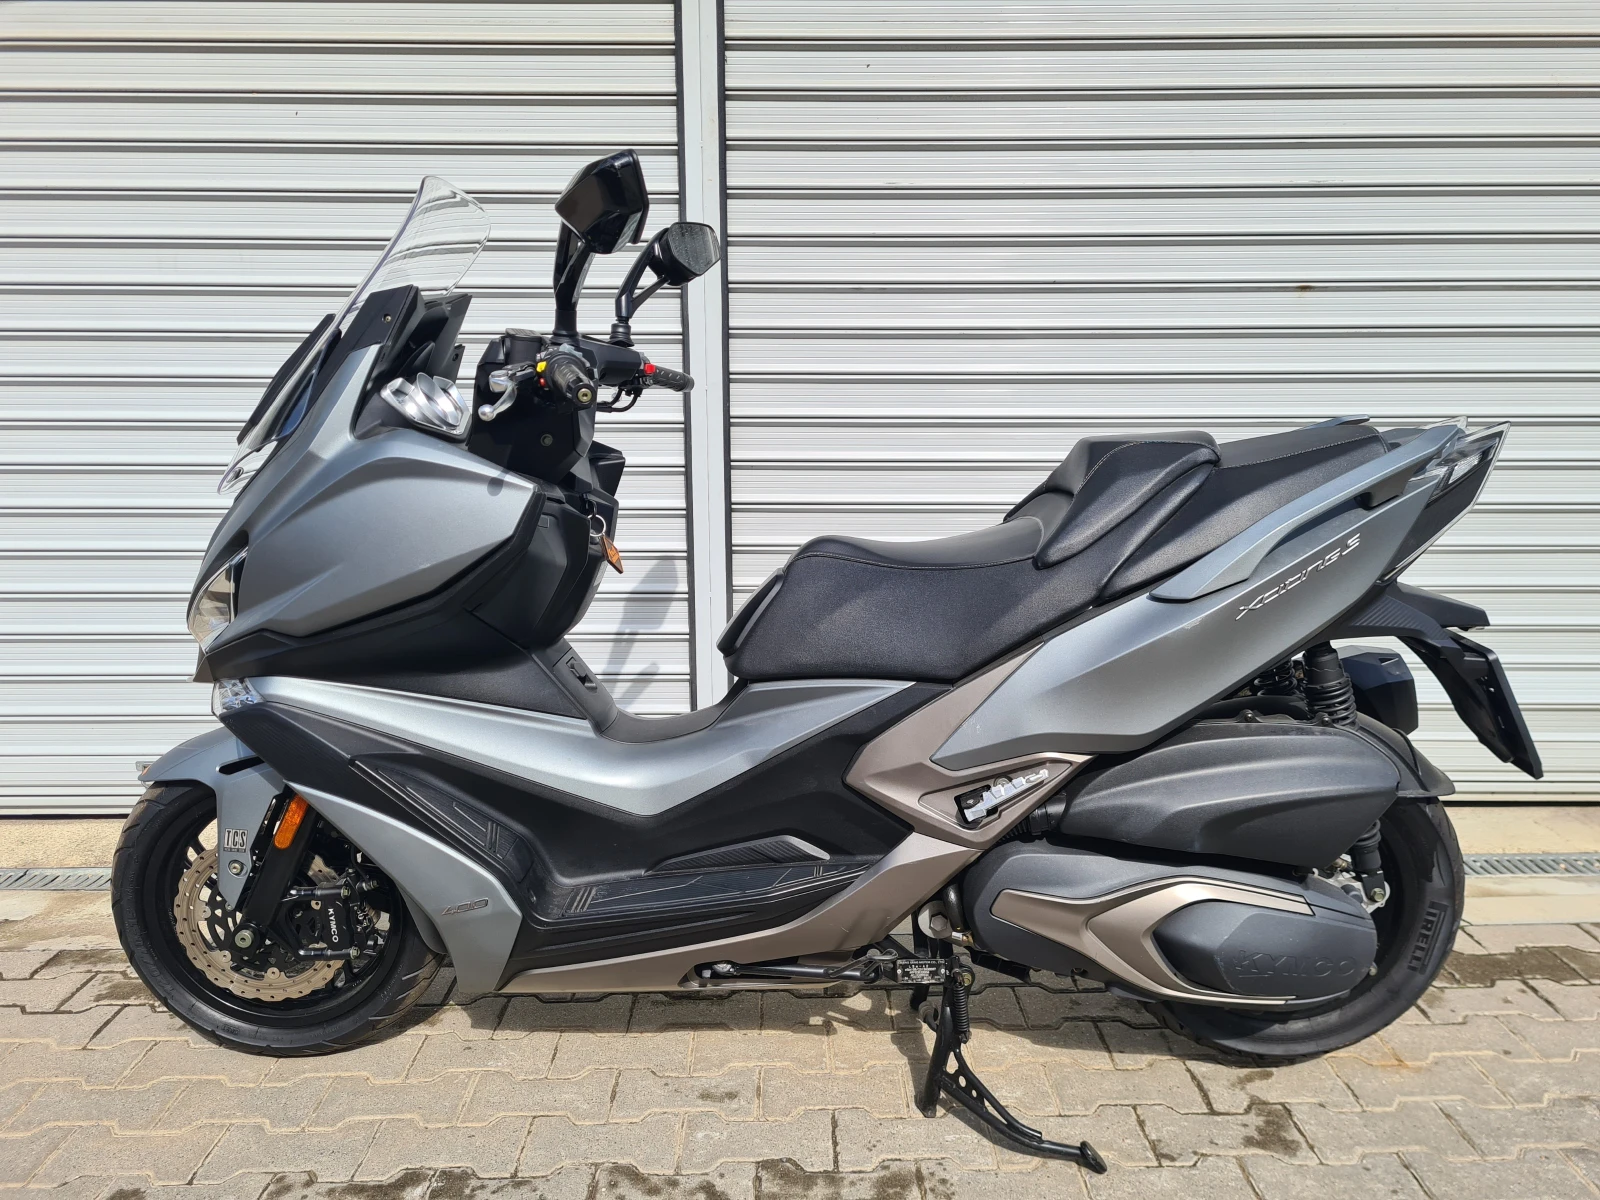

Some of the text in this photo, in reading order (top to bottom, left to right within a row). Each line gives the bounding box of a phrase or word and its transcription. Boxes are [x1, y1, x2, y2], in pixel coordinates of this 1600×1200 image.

[1341, 532, 1361, 556] S
[226, 830, 247, 848] TCS
[441, 898, 489, 916] 400
[327, 907, 340, 943] KYMCO
[1407, 901, 1450, 975] PIRELLI
[1234, 951, 1358, 977] KYMCO
